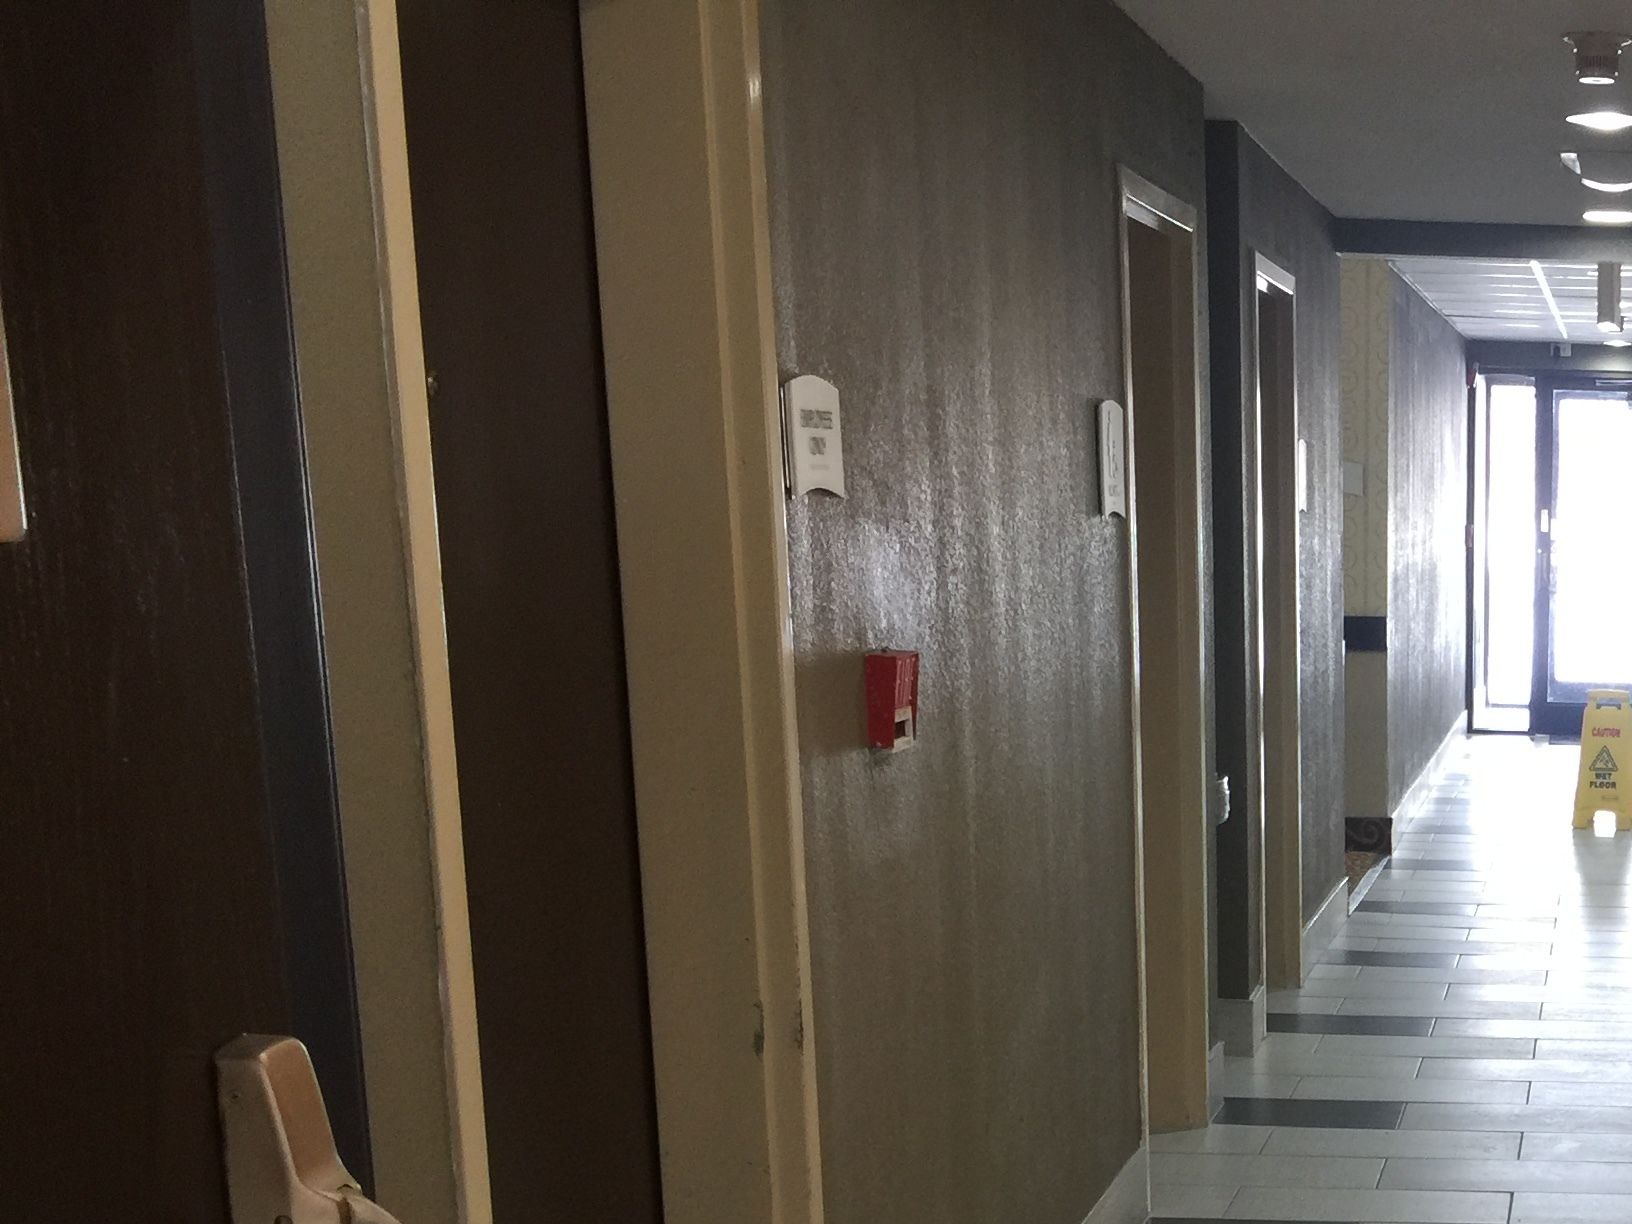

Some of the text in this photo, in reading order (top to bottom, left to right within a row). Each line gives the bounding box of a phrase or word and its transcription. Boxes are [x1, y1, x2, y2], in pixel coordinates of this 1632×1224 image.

[1591, 727, 1621, 738] CAUTION
[1594, 772, 1612, 780] WET
[1589, 781, 1617, 789] FLOOR
